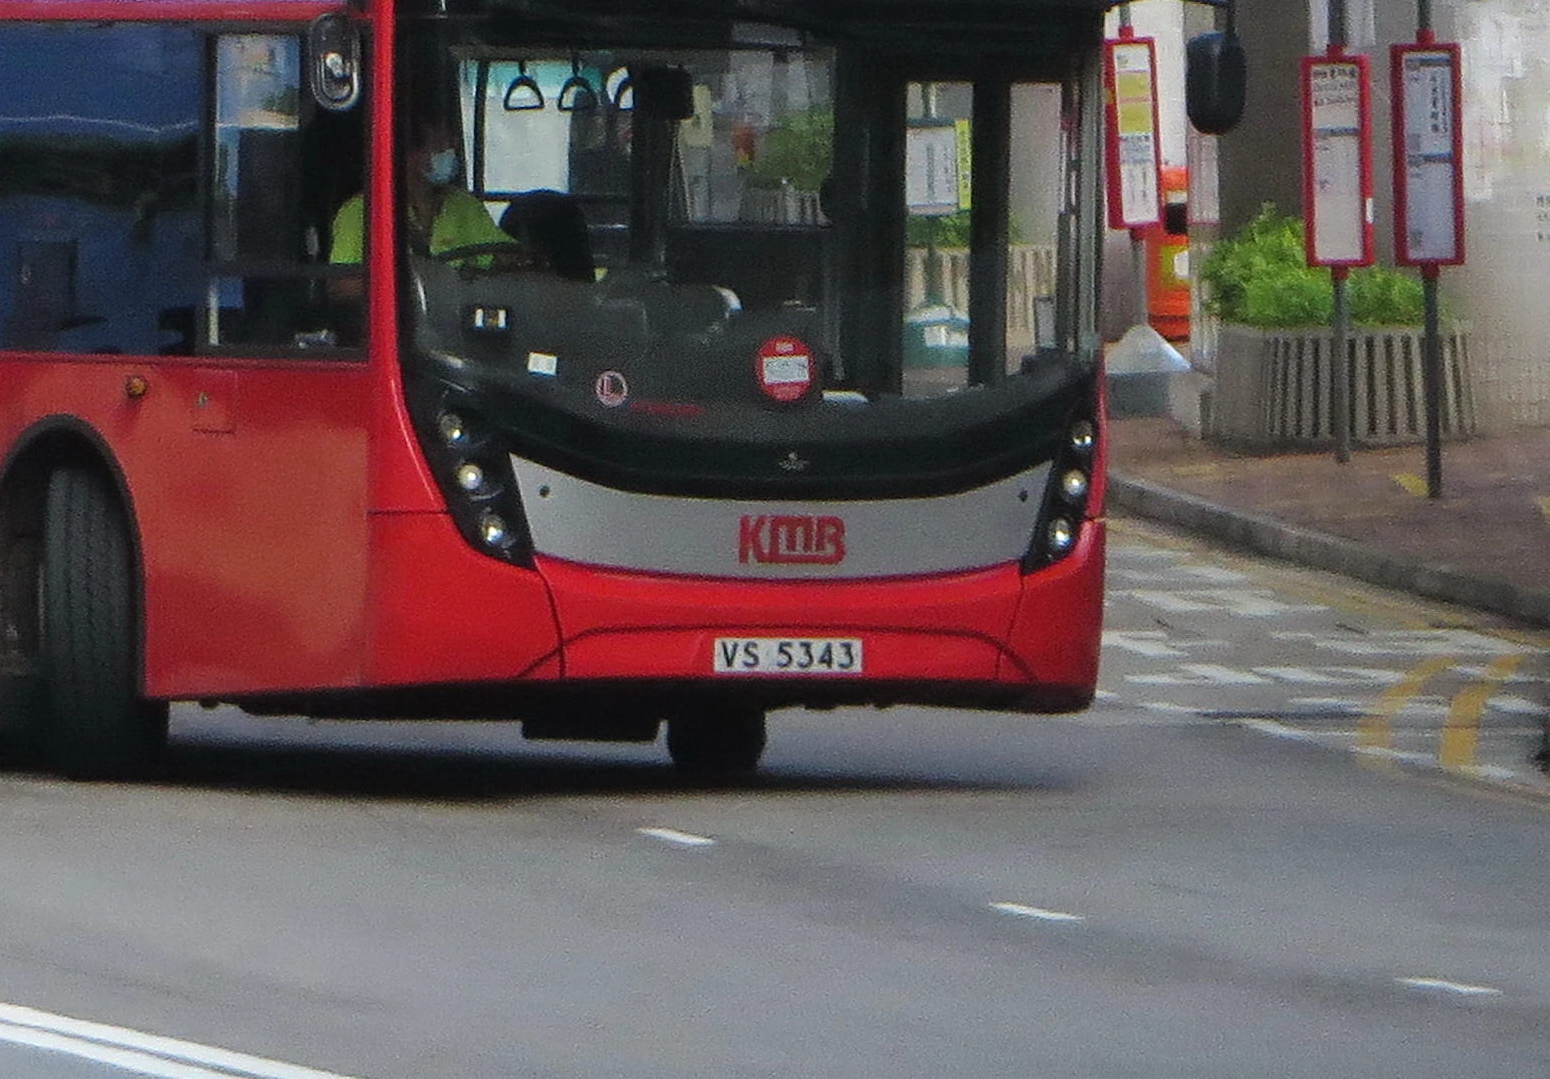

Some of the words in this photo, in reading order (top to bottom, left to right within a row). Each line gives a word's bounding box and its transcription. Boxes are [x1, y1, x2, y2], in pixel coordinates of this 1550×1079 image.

[738, 514, 847, 566] KMB
[721, 641, 760, 668] VS
[776, 640, 855, 670] 5343
